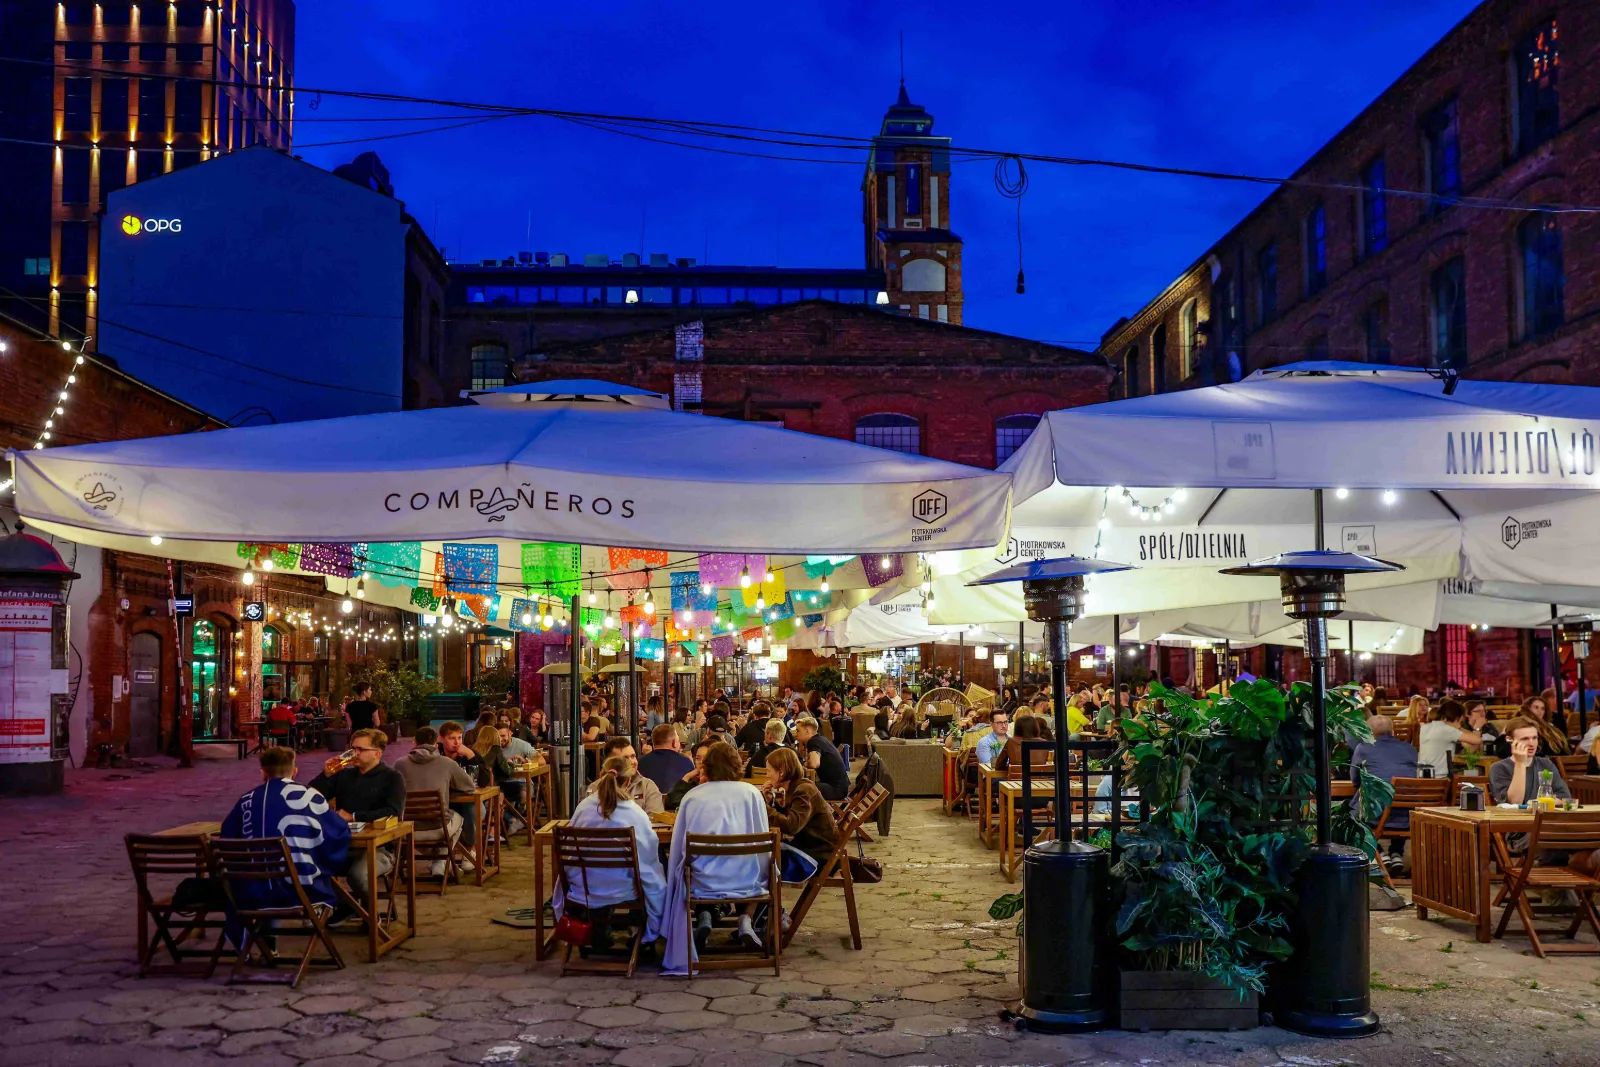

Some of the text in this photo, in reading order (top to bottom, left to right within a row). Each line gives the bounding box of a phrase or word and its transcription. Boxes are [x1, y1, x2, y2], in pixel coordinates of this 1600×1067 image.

[144, 219, 182, 233] OPG
[384, 483, 635, 521] COMPAÑEROS
[919, 499, 942, 516] OFF
[1521, 519, 1552, 530] PIOTRKOWSKA
[911, 527, 948, 535] PIOTRKOWSKA
[1505, 524, 1518, 542] OFF
[1521, 529, 1538, 540] CENTER
[911, 534, 932, 542] CENTER
[1020, 540, 1066, 550] PIOTRKOWSKA
[1020, 549, 1045, 557] CENTER
